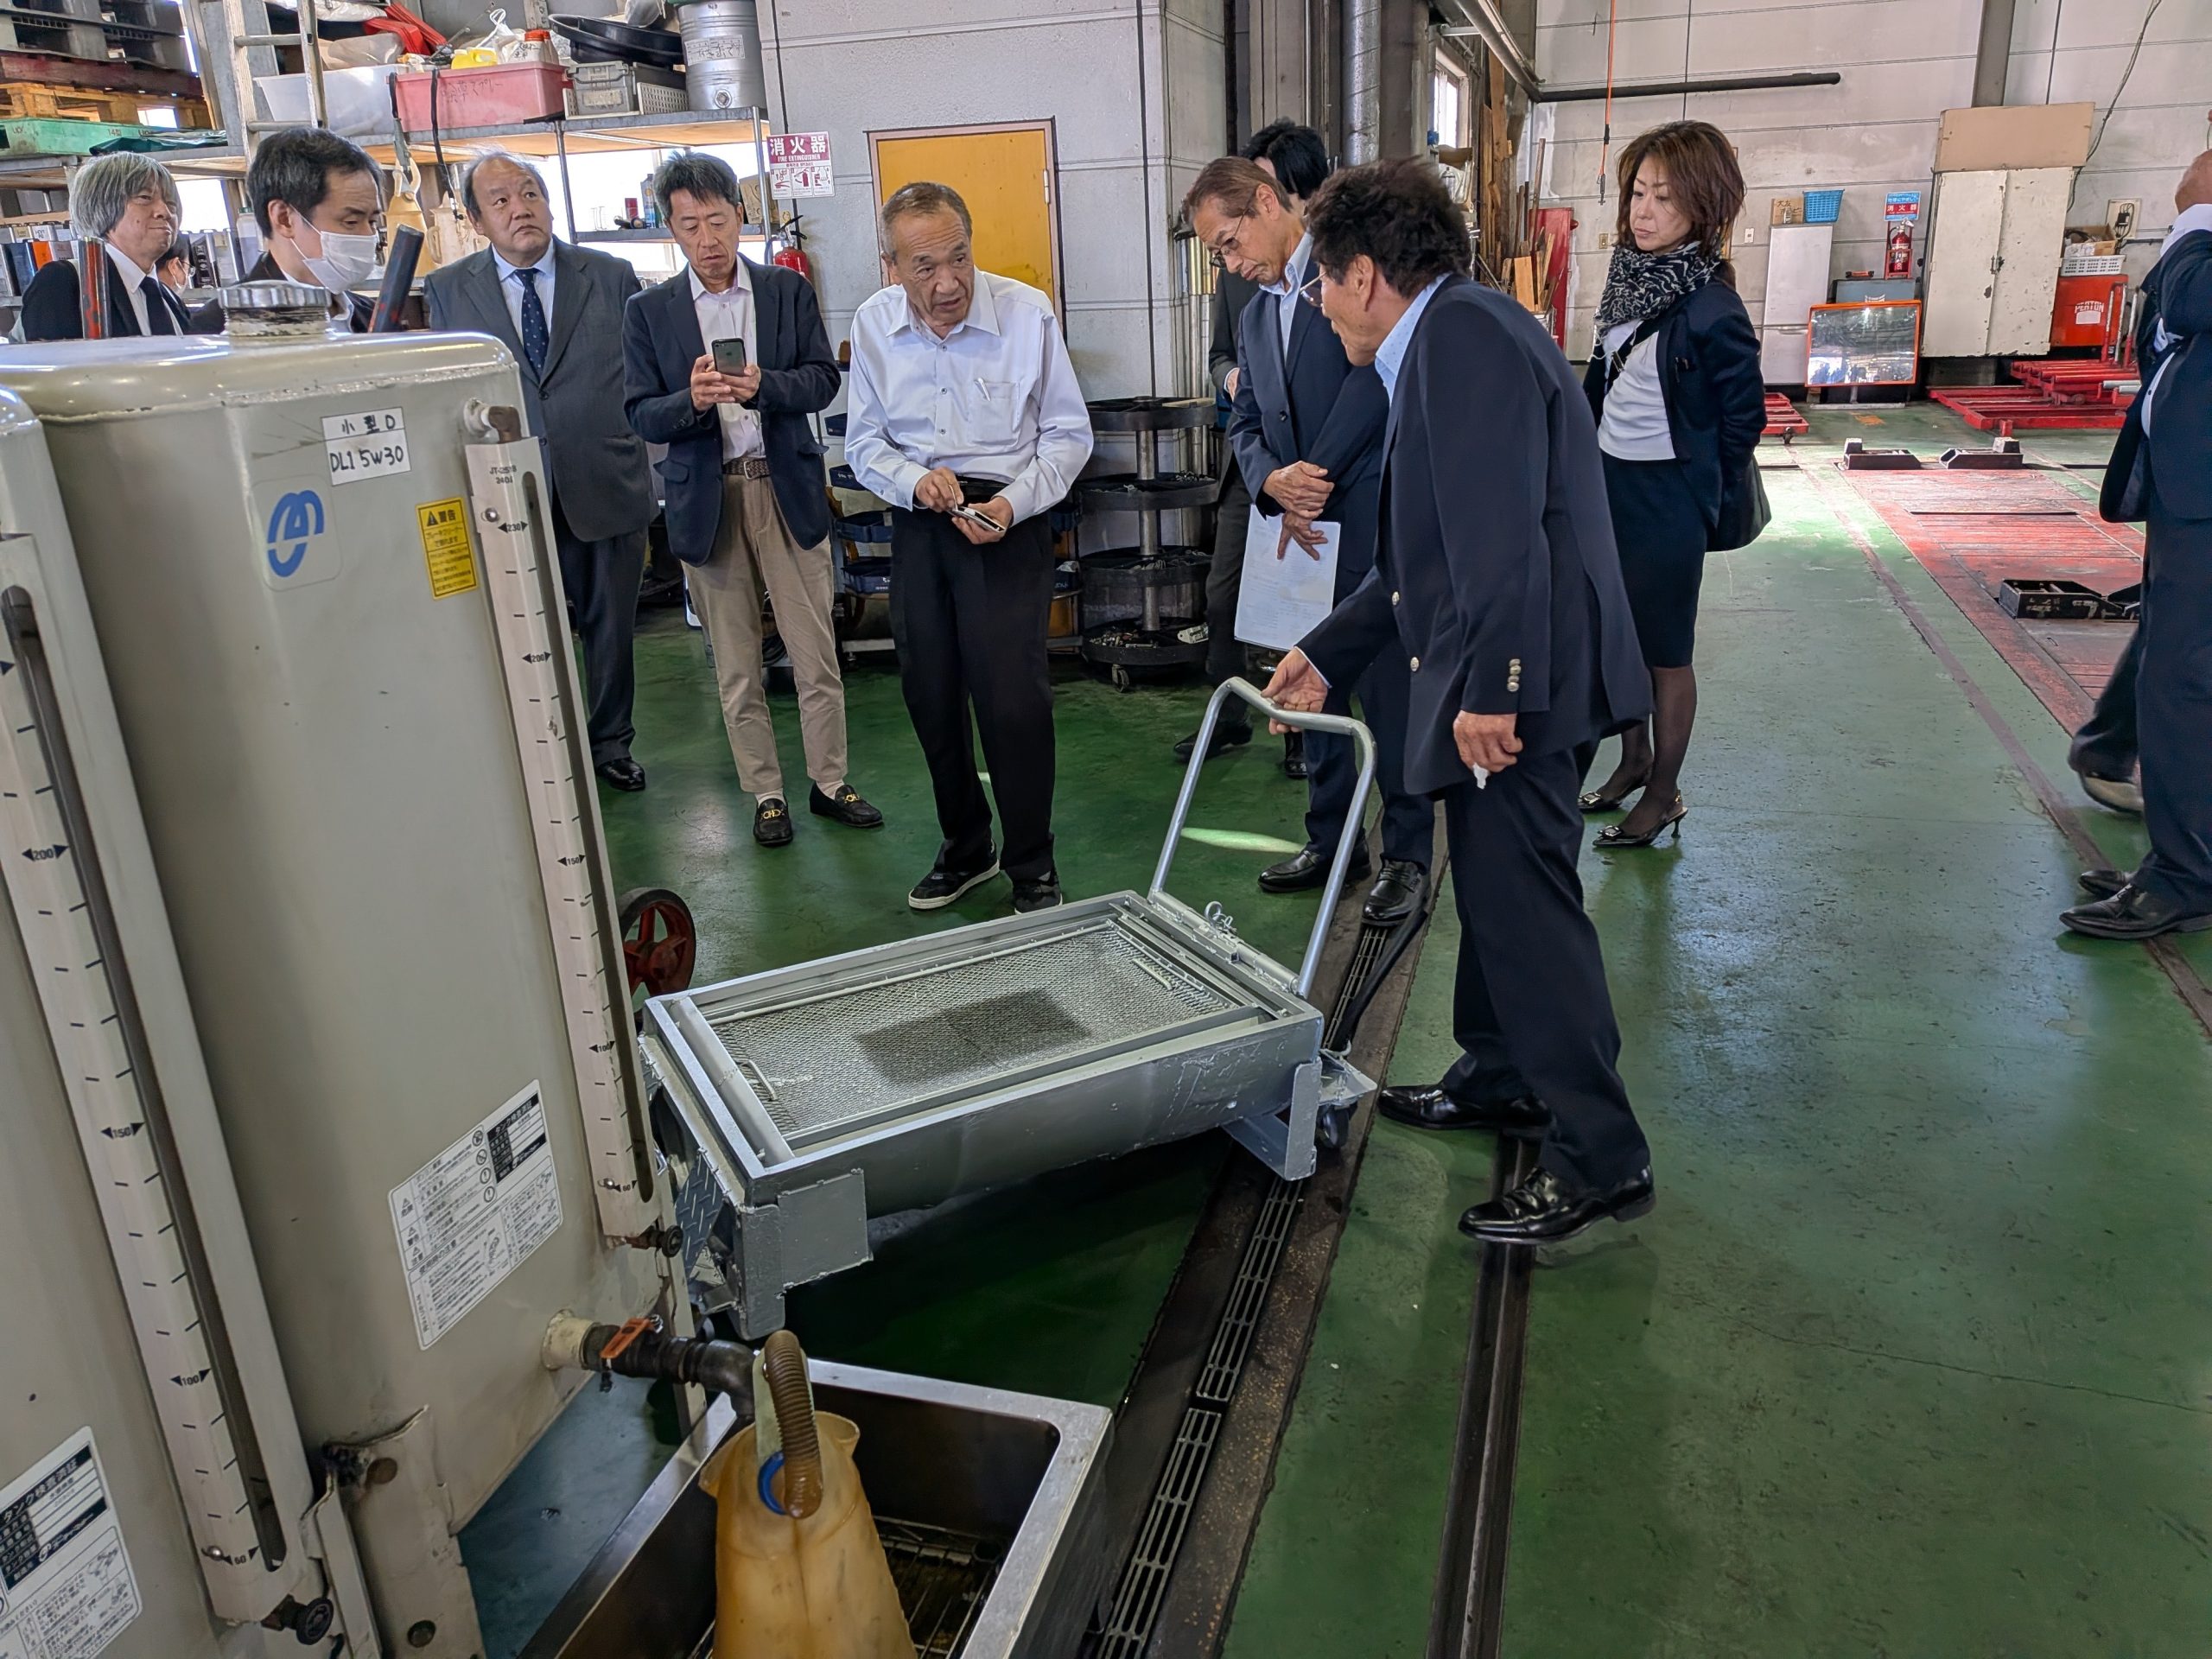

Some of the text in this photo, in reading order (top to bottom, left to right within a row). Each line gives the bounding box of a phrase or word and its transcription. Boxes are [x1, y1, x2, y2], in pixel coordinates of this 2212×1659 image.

[769, 135, 826, 156] 消火器
[330, 445, 404, 473] DL1 5W30
[507, 523, 521, 532] 230
[531, 654, 545, 663] 200
[33, 849, 54, 861] 200
[567, 856, 580, 866] 150
[112, 1126, 131, 1139] 150
[181, 1375, 200, 1386] 100
[234, 1554, 247, 1565] 60
